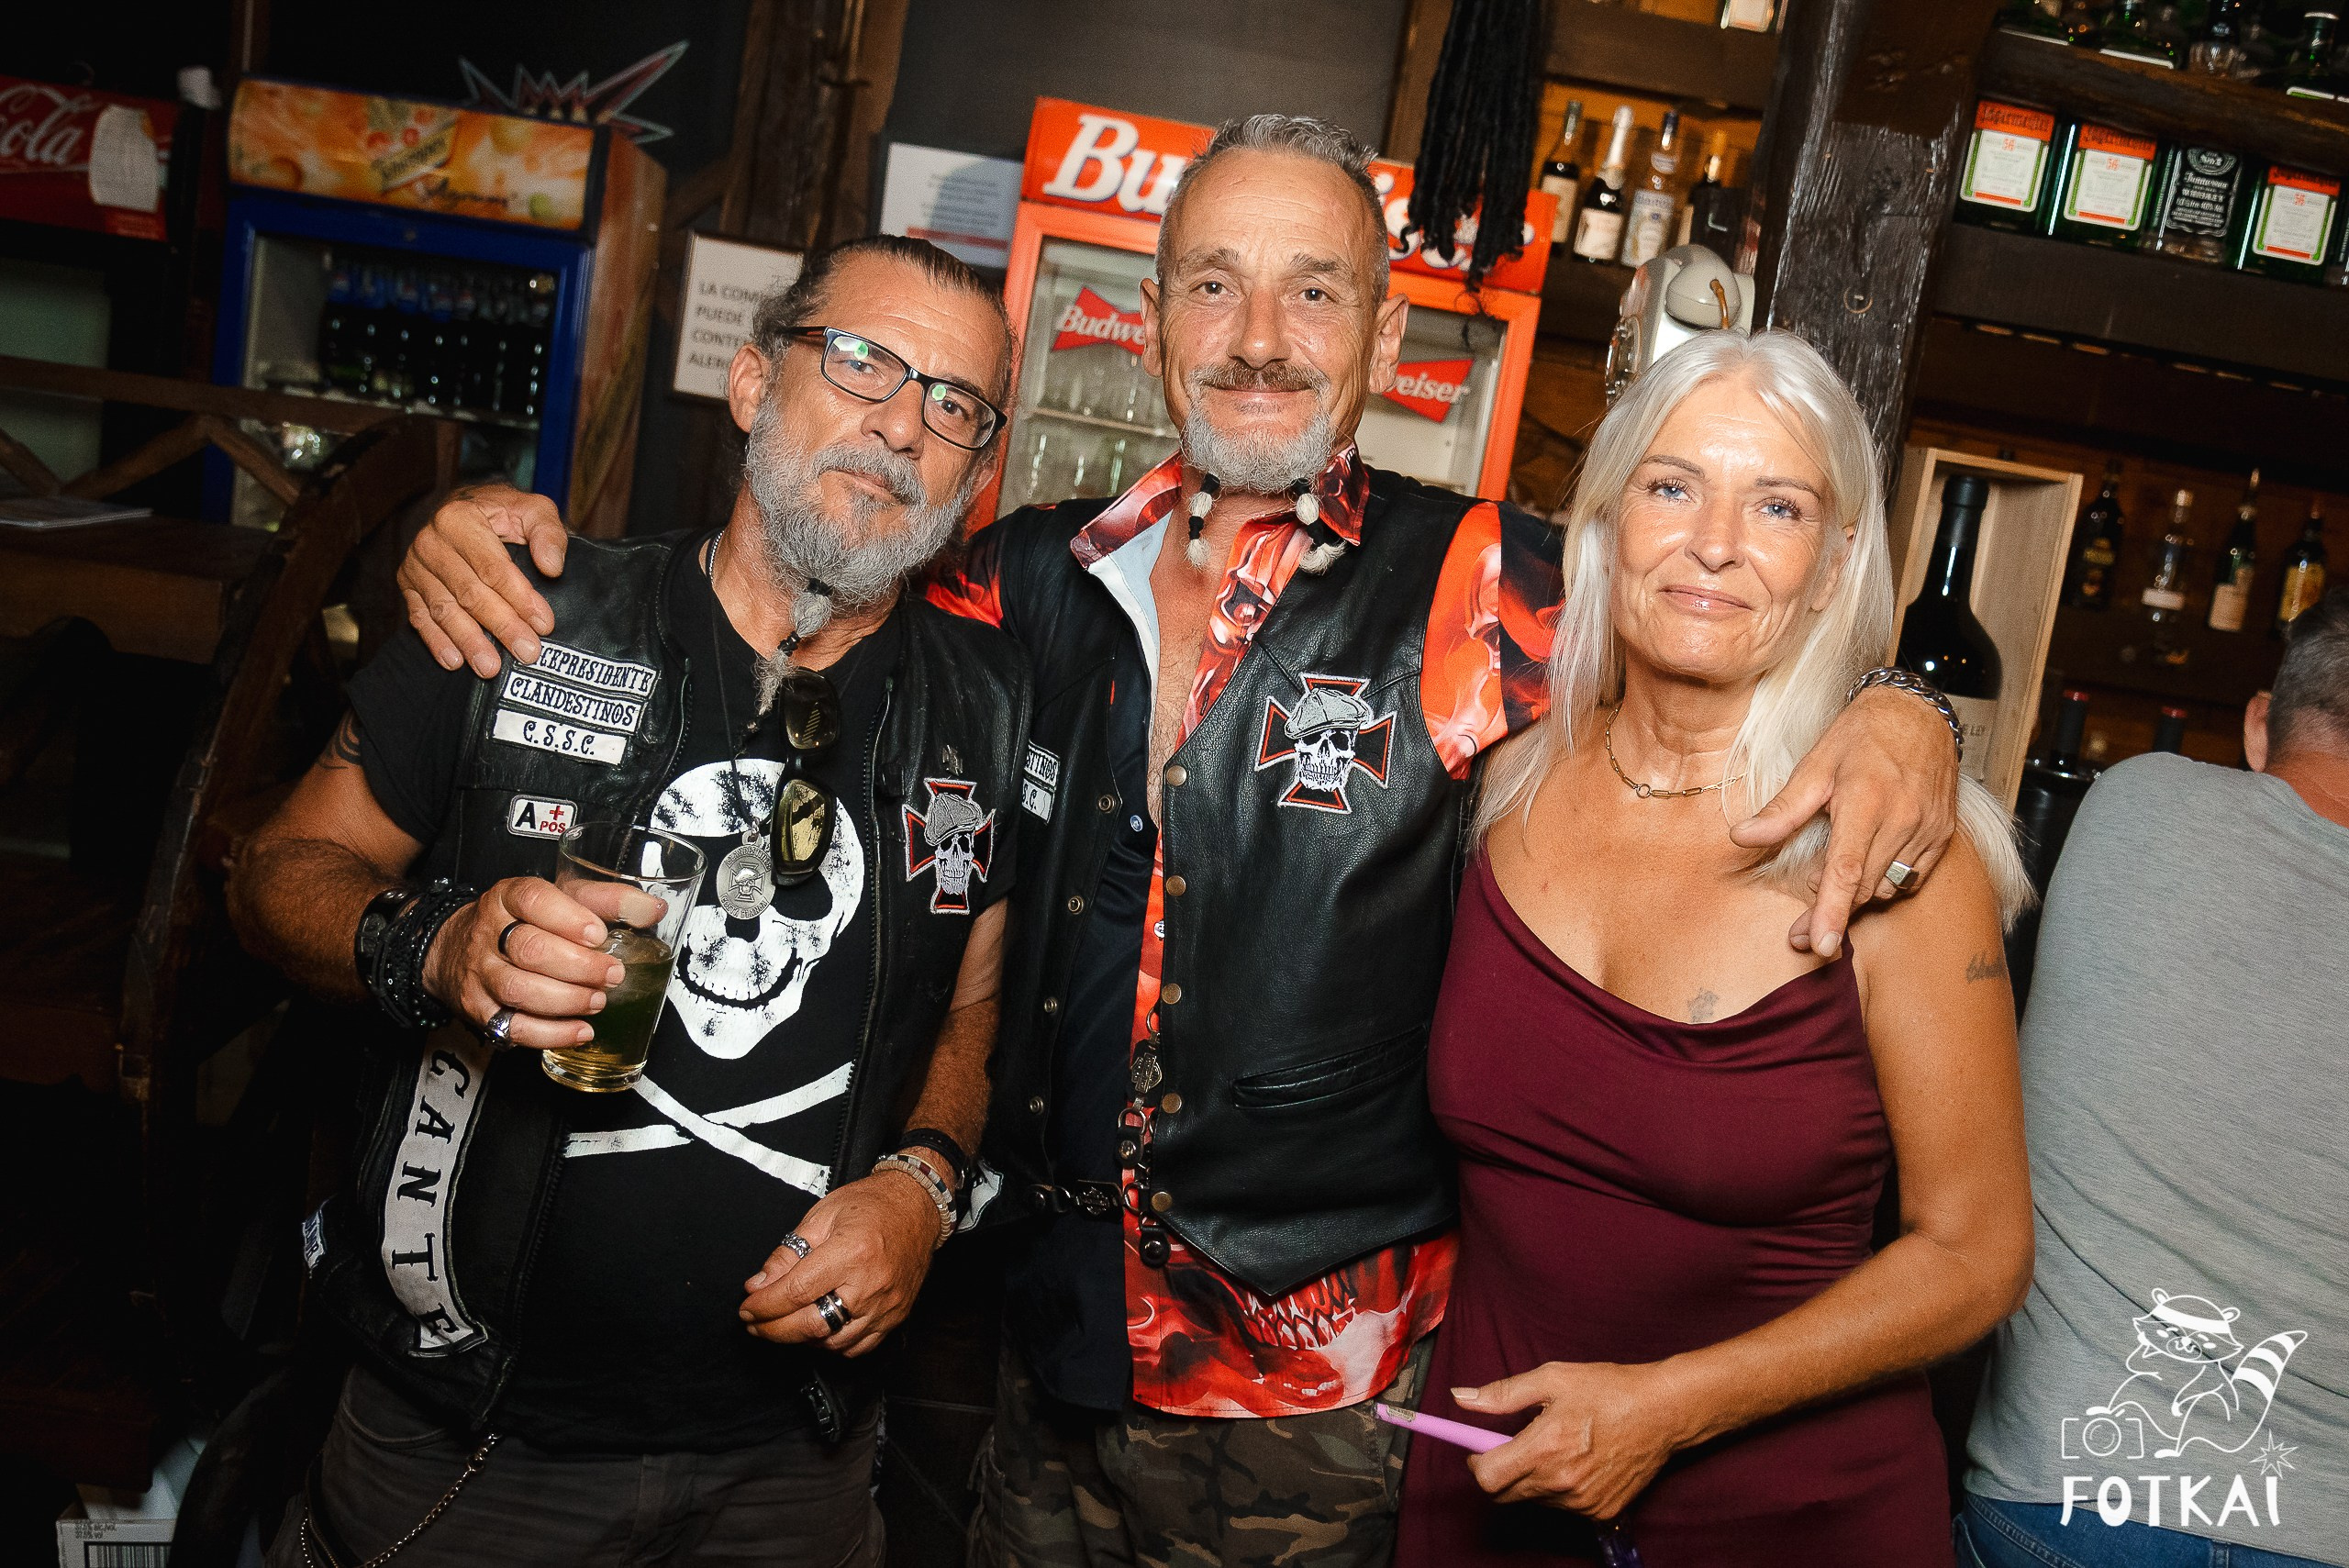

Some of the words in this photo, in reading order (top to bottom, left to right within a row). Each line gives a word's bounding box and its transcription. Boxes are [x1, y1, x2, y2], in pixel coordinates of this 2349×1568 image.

[0, 84, 95, 166] ola
[699, 282, 718, 295] LA
[696, 306, 743, 326] PUEDE
[510, 677, 637, 727] CLANDESTINOS
[523, 720, 595, 755] C.S.S.C.
[540, 821, 566, 833] POS
